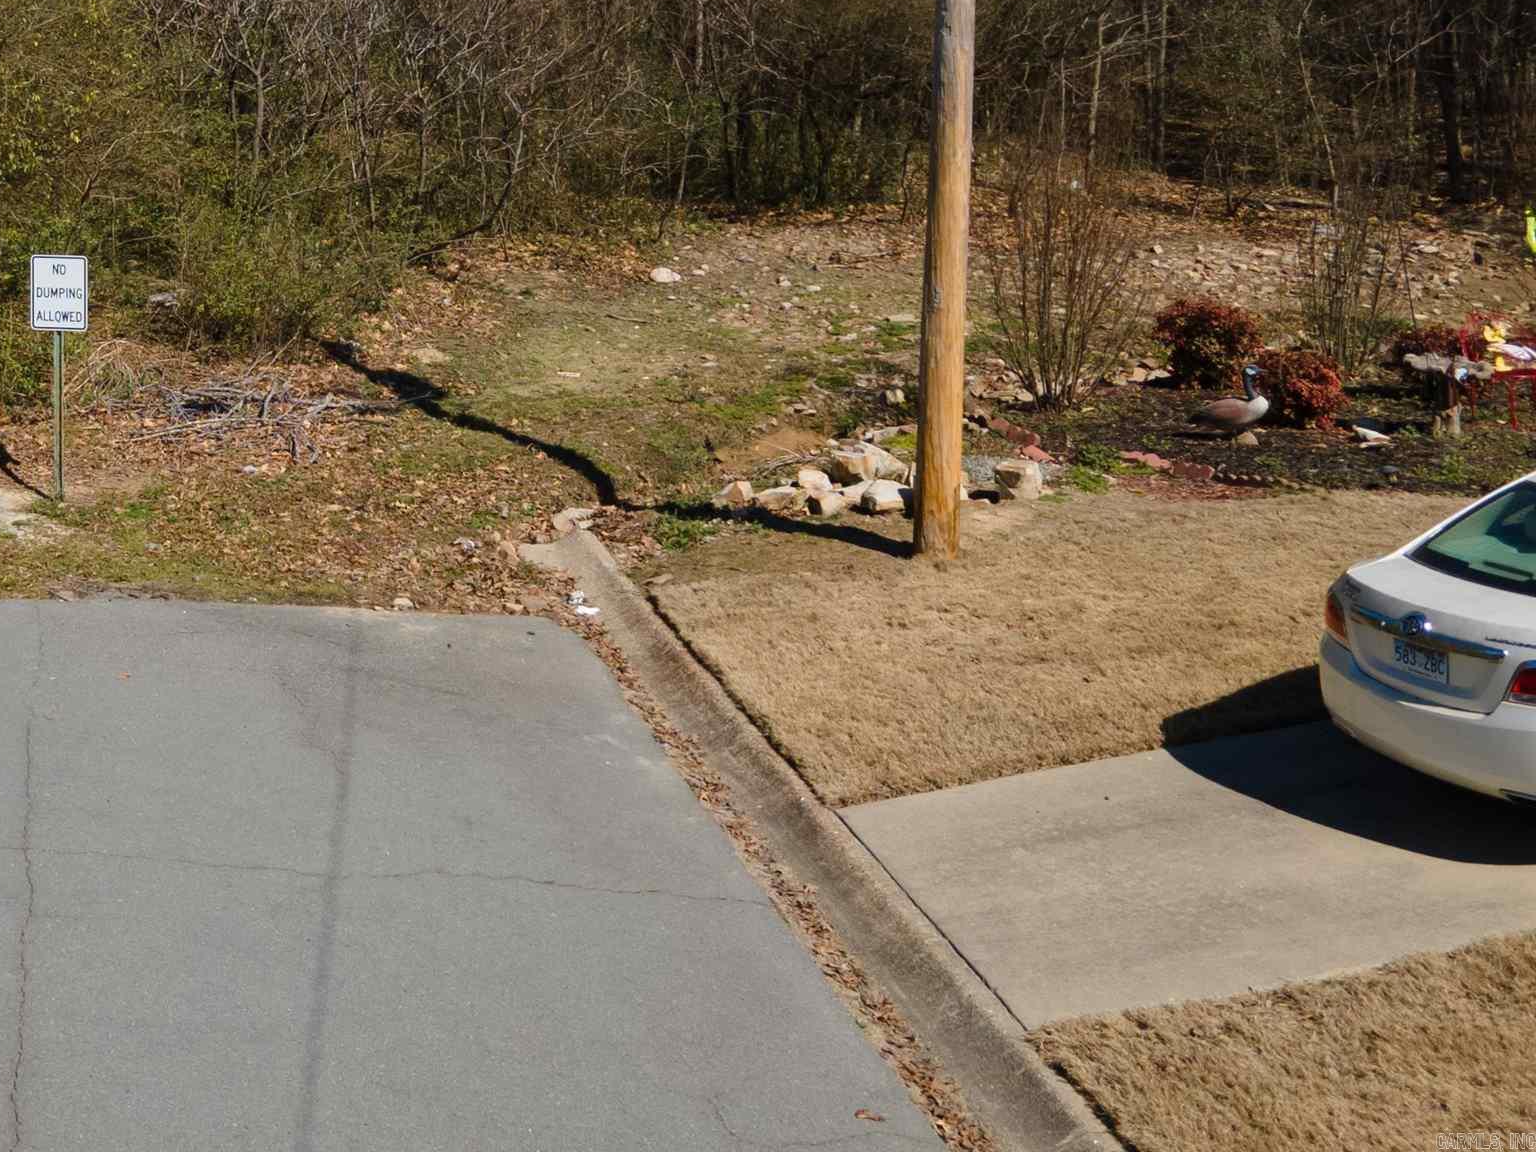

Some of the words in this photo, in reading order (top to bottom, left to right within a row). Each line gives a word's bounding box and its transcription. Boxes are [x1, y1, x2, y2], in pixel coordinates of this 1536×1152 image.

[52, 264, 66, 275] NO
[36, 287, 83, 299] DUMPING
[36, 310, 82, 323] ALLOWED
